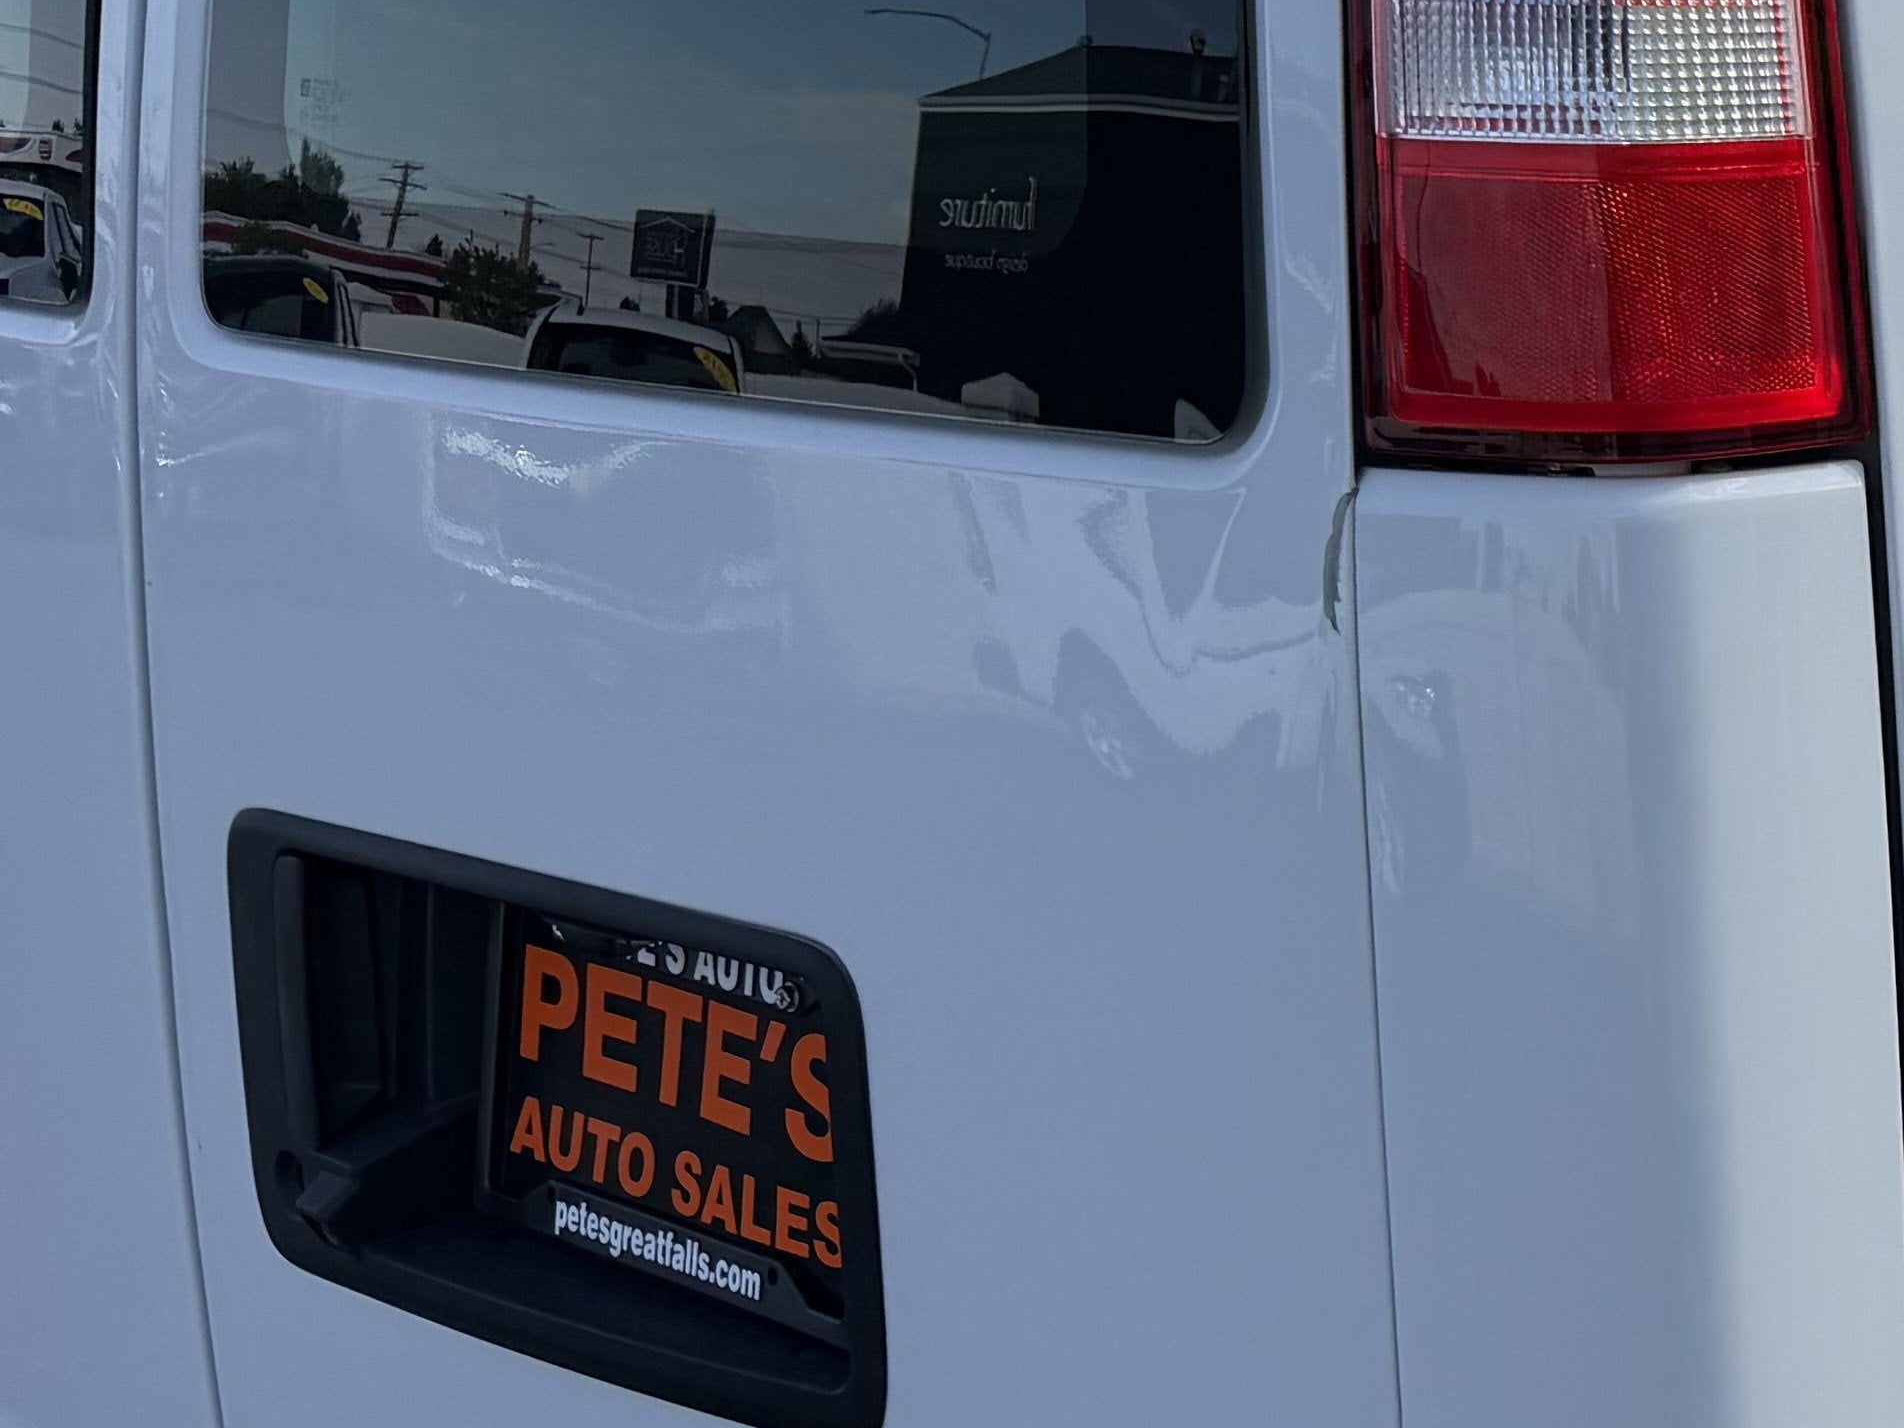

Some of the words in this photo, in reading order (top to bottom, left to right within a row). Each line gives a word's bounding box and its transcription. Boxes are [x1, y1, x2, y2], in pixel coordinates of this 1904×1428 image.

[519, 944, 834, 1163] PETE'S
[509, 1096, 656, 1199] AUTO
[670, 1150, 843, 1269] SALES
[554, 1198, 762, 1301] petesgreatfalls.com
